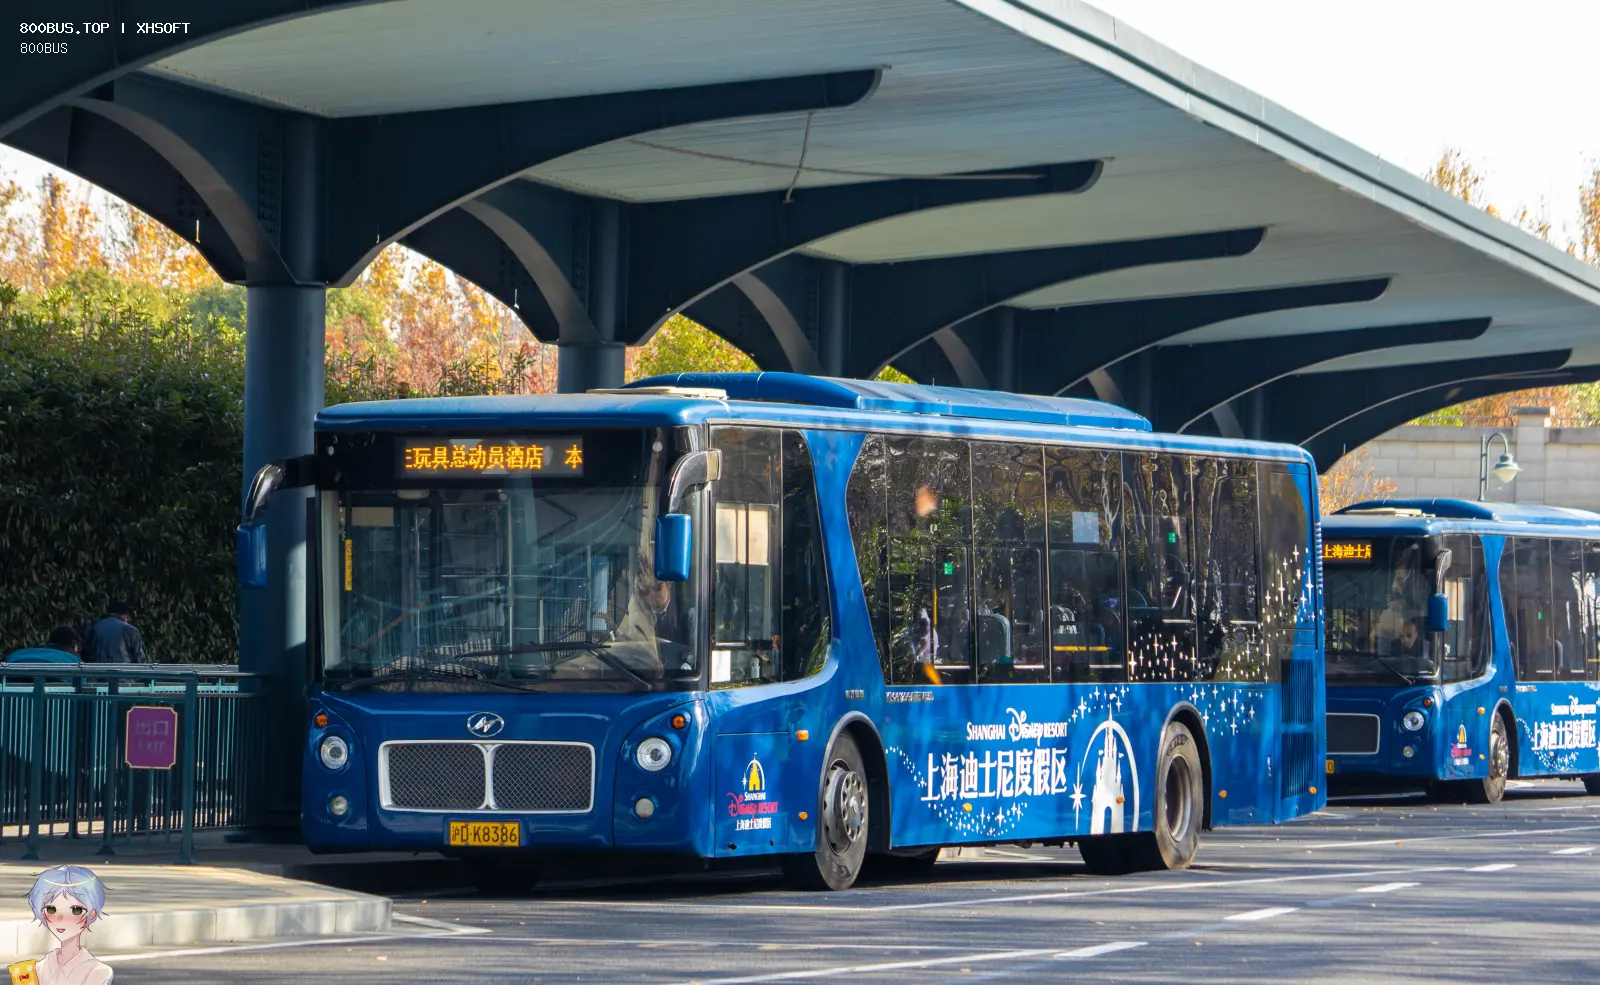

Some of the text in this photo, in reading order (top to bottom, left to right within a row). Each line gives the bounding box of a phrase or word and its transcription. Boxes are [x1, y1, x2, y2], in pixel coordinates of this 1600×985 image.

[564, 444, 583, 469] 本
[134, 719, 169, 737] 出口
[966, 721, 1006, 741] SHANGHAI
[1043, 721, 1068, 738] RESORT
[920, 747, 1068, 801] 上海迪士尼度假区
